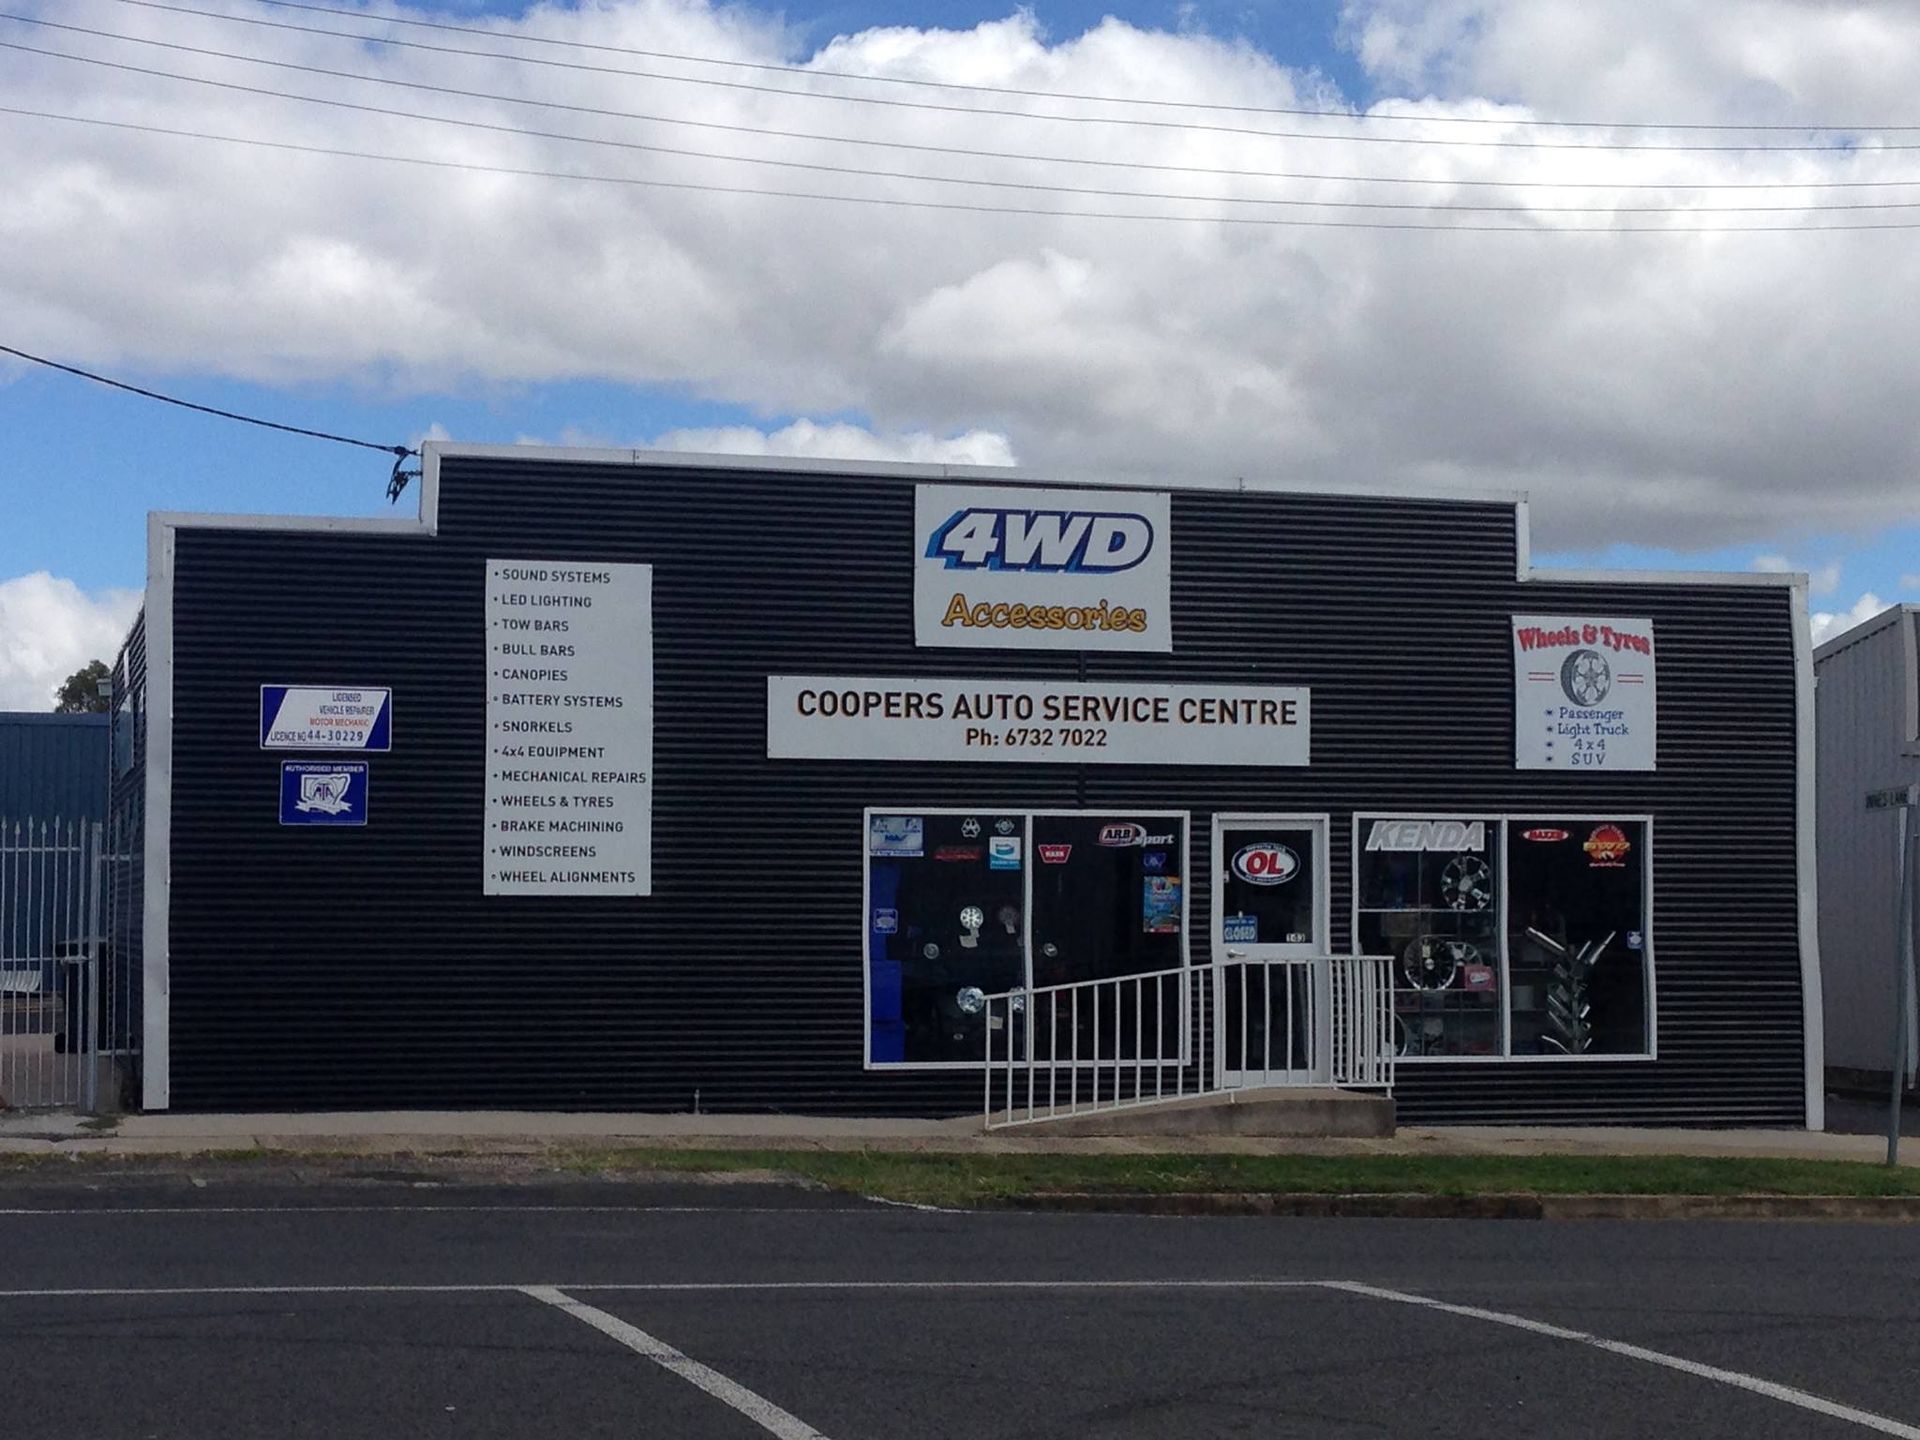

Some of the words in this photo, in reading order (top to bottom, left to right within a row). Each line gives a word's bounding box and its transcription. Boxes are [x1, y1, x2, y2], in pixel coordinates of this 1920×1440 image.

[924, 508, 1154, 574] 4WD
[502, 569, 548, 582] SOUND
[551, 570, 611, 584] SYSTEMS
[501, 594, 527, 606] LED
[530, 595, 592, 608] LIGHTING
[941, 593, 1147, 631] Accessories
[502, 619, 531, 631] TOW
[534, 620, 569, 632] BARS
[1517, 626, 1581, 652] Wheels
[1582, 624, 1598, 645] &
[1600, 626, 1650, 655] Tyres
[502, 643, 537, 656] BULL
[540, 645, 576, 657] BARS
[501, 669, 568, 682] CANOPIES
[502, 694, 560, 707] BATTERY
[564, 695, 623, 708] SYSTEMS
[797, 690, 944, 718] COOPERS
[952, 693, 1033, 720] AUTO
[1042, 695, 1169, 723] SERVICE
[1179, 699, 1297, 725] CENTRE
[1559, 707, 1624, 722] Passenger
[502, 721, 573, 733] SNORKELS
[1558, 723, 1590, 739] Light
[1593, 723, 1629, 735] Truck
[307, 730, 363, 741] 44-30229
[966, 728, 999, 747] Ph:
[1005, 728, 1053, 746] 6732
[1059, 728, 1107, 747] 7022
[528, 746, 605, 759] EQUIPMENT
[501, 771, 588, 783] MECHANICAL
[591, 772, 647, 784] REPAIRS
[500, 796, 557, 808] WHEELS
[560, 796, 569, 807] &
[573, 796, 614, 808] TYRES
[500, 820, 545, 833] BRAKE
[549, 821, 624, 833] MACHINING
[1104, 829, 1131, 839] ARB
[1365, 820, 1485, 851] KENDA
[499, 846, 597, 858] WINDSCREENS
[1246, 851, 1284, 876] OL
[499, 871, 547, 883] WHEEL
[550, 872, 636, 884] ALIGNMENTS
